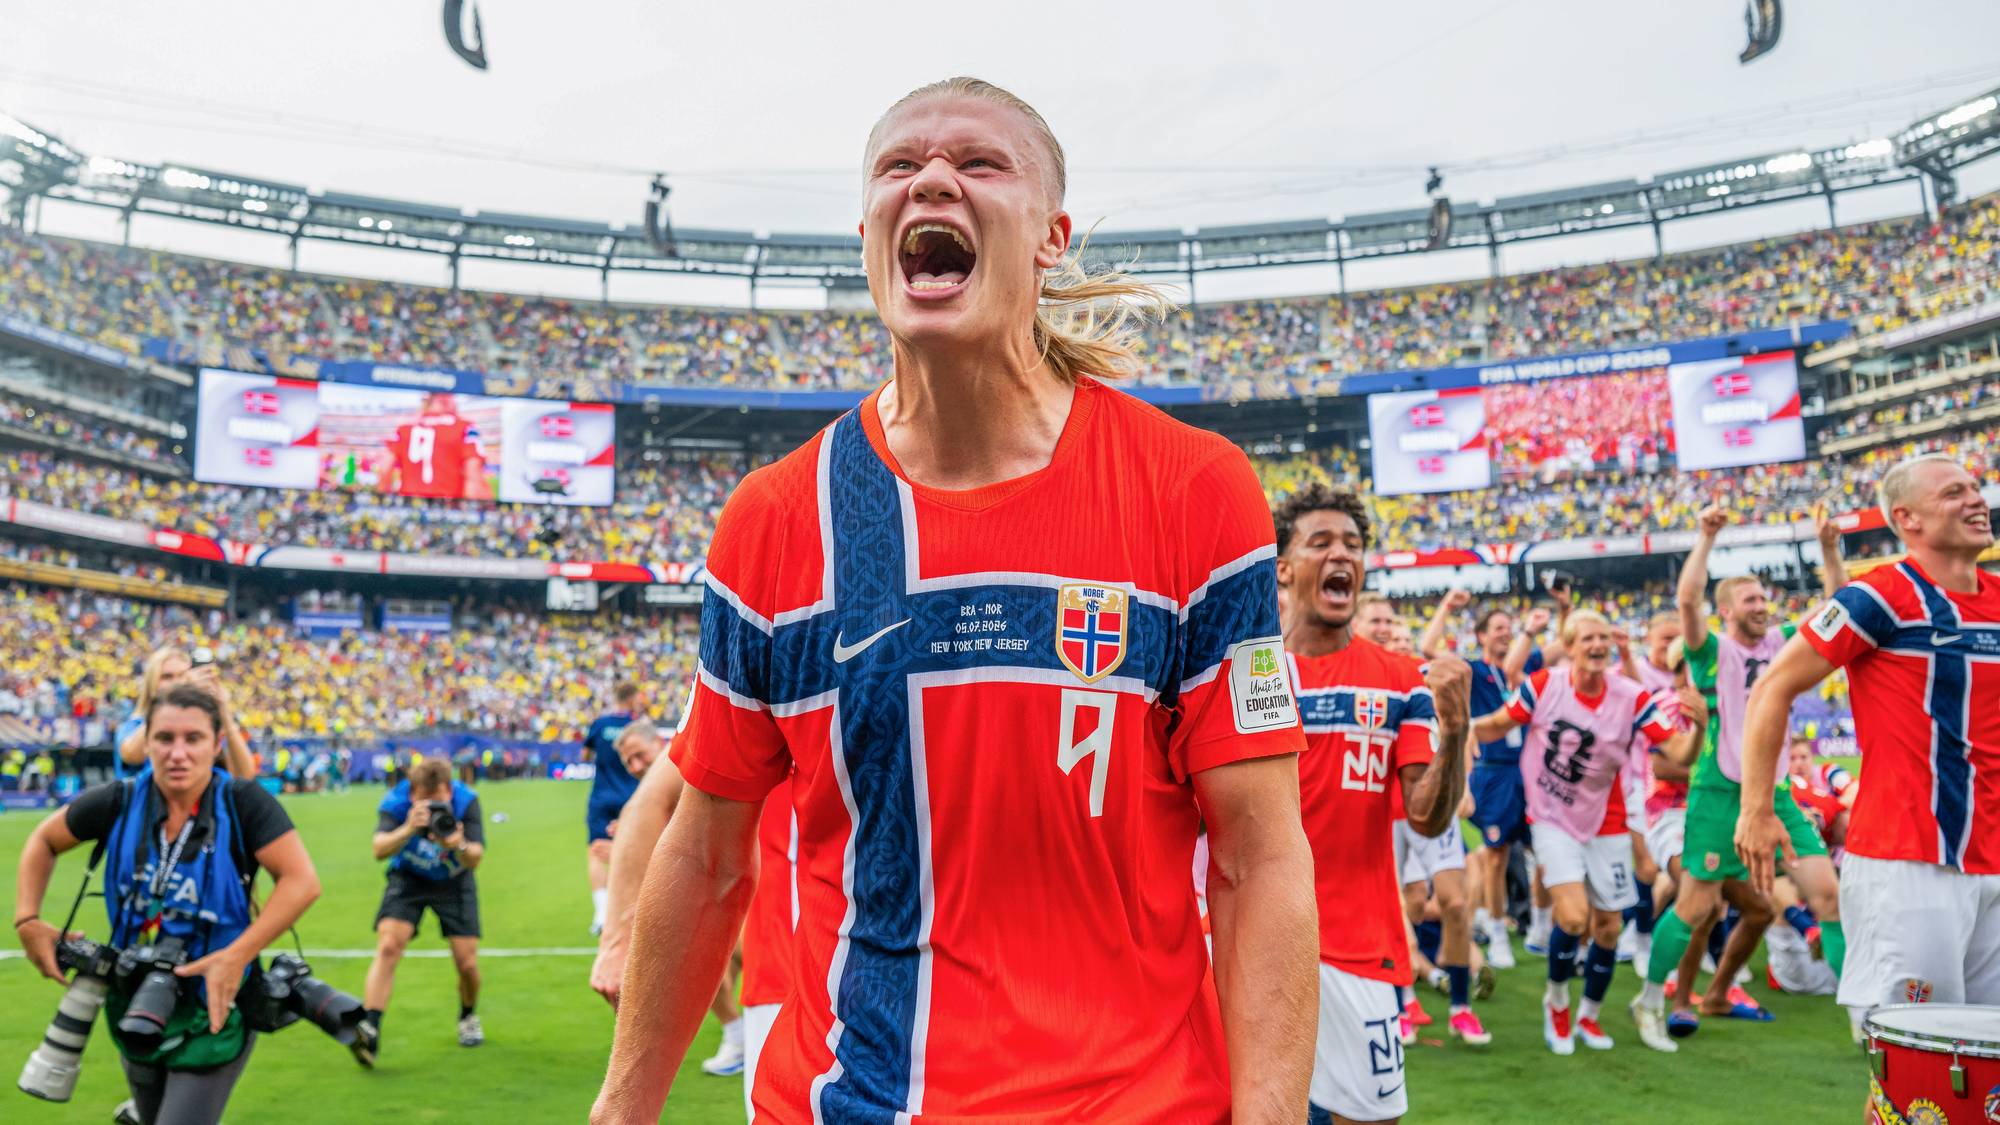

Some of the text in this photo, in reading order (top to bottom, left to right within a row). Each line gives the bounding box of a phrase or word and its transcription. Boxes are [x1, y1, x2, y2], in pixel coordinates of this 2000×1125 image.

[1479, 366, 1515, 384] FIFA
[1515, 358, 1575, 380] WORLD
[1576, 354, 1610, 374] CUP
[408, 425, 436, 485] 9
[1083, 588, 1104, 598] NORGE
[961, 605, 976, 616] BRA
[985, 603, 1003, 615] NOR
[955, 620, 1007, 634] 05.07.2026
[931, 638, 1029, 653] NEW YORK NEW JERSEY
[1250, 679, 1271, 695] Unite
[1245, 694, 1290, 712] EDUCATION
[1263, 711, 1280, 720] FIFA
[1057, 688, 1118, 817] 9
[1341, 732, 1393, 793] 22
